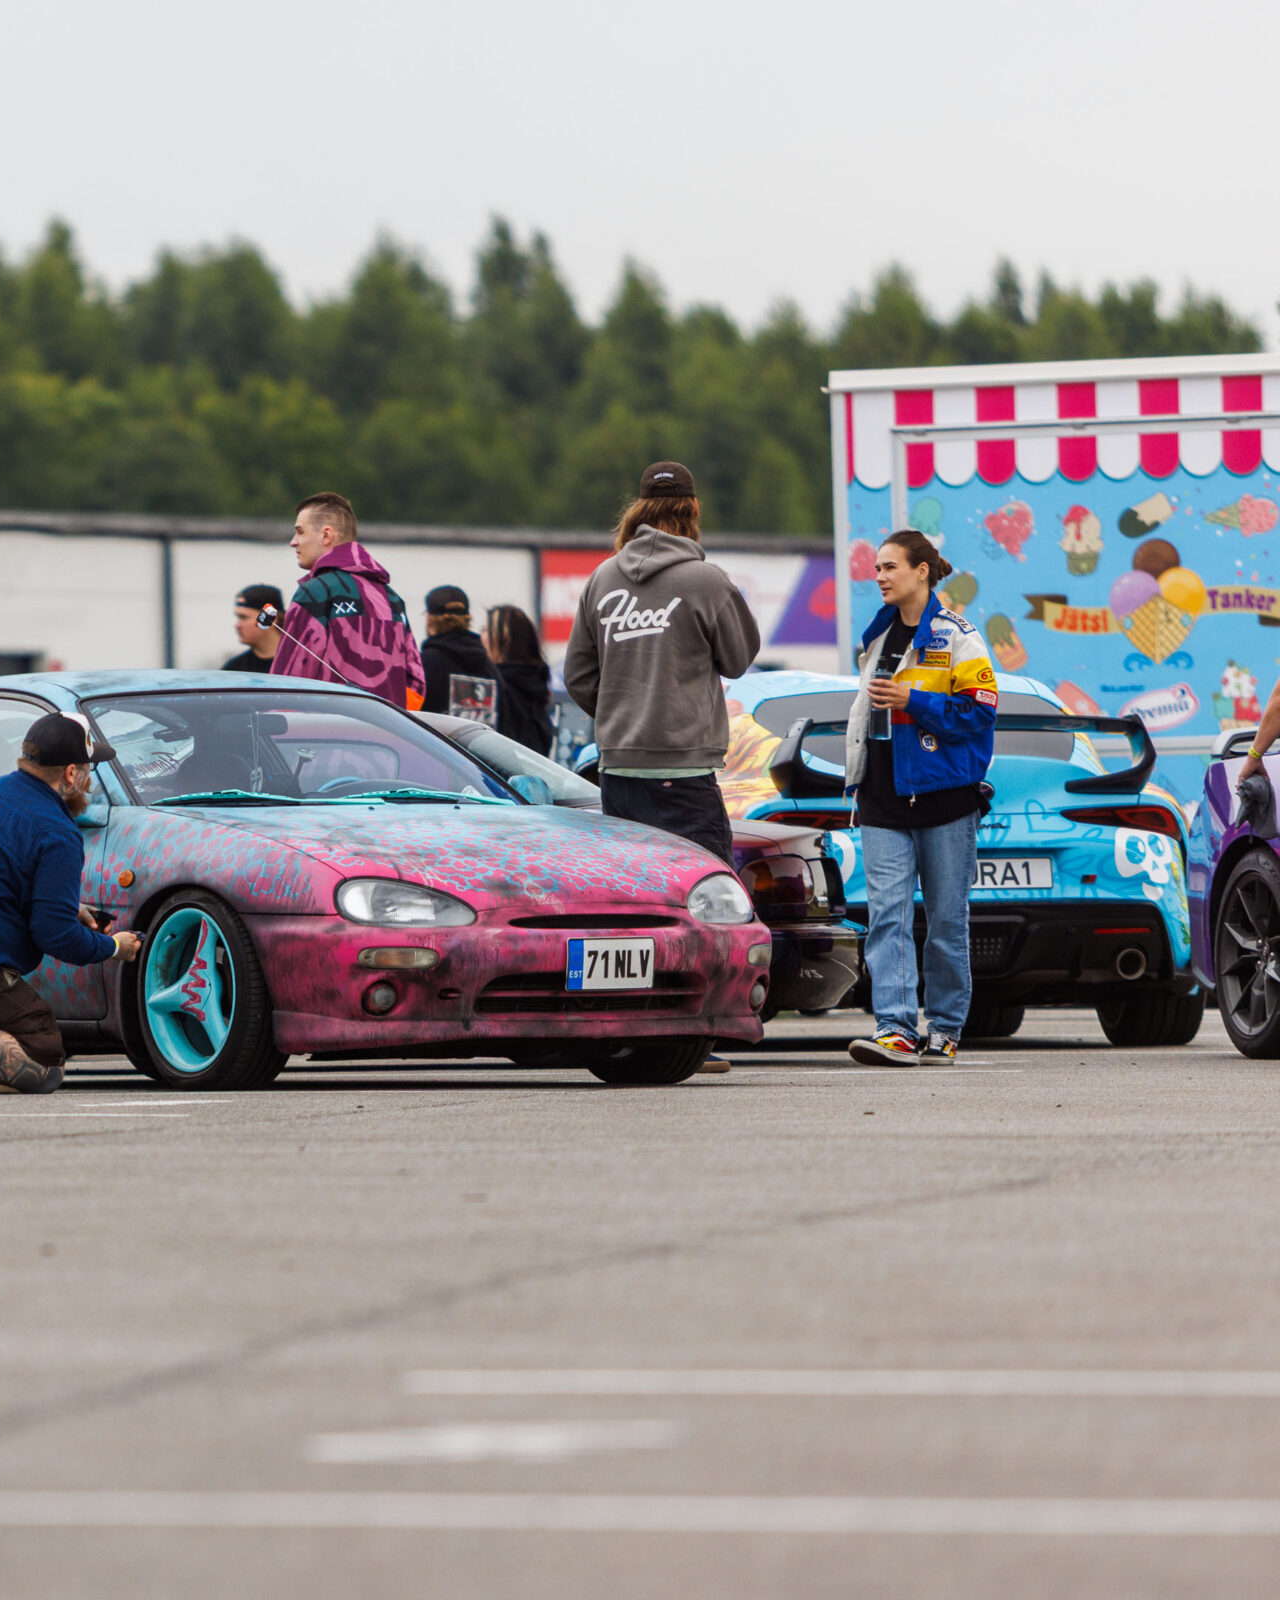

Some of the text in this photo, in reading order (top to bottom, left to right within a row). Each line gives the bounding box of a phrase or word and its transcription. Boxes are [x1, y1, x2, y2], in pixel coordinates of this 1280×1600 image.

[1208, 589, 1277, 613] Tanker
[597, 589, 682, 644] Hood
[980, 670, 993, 680] 67
[569, 970, 583, 979] EST
[587, 949, 650, 979] 71 NLV
